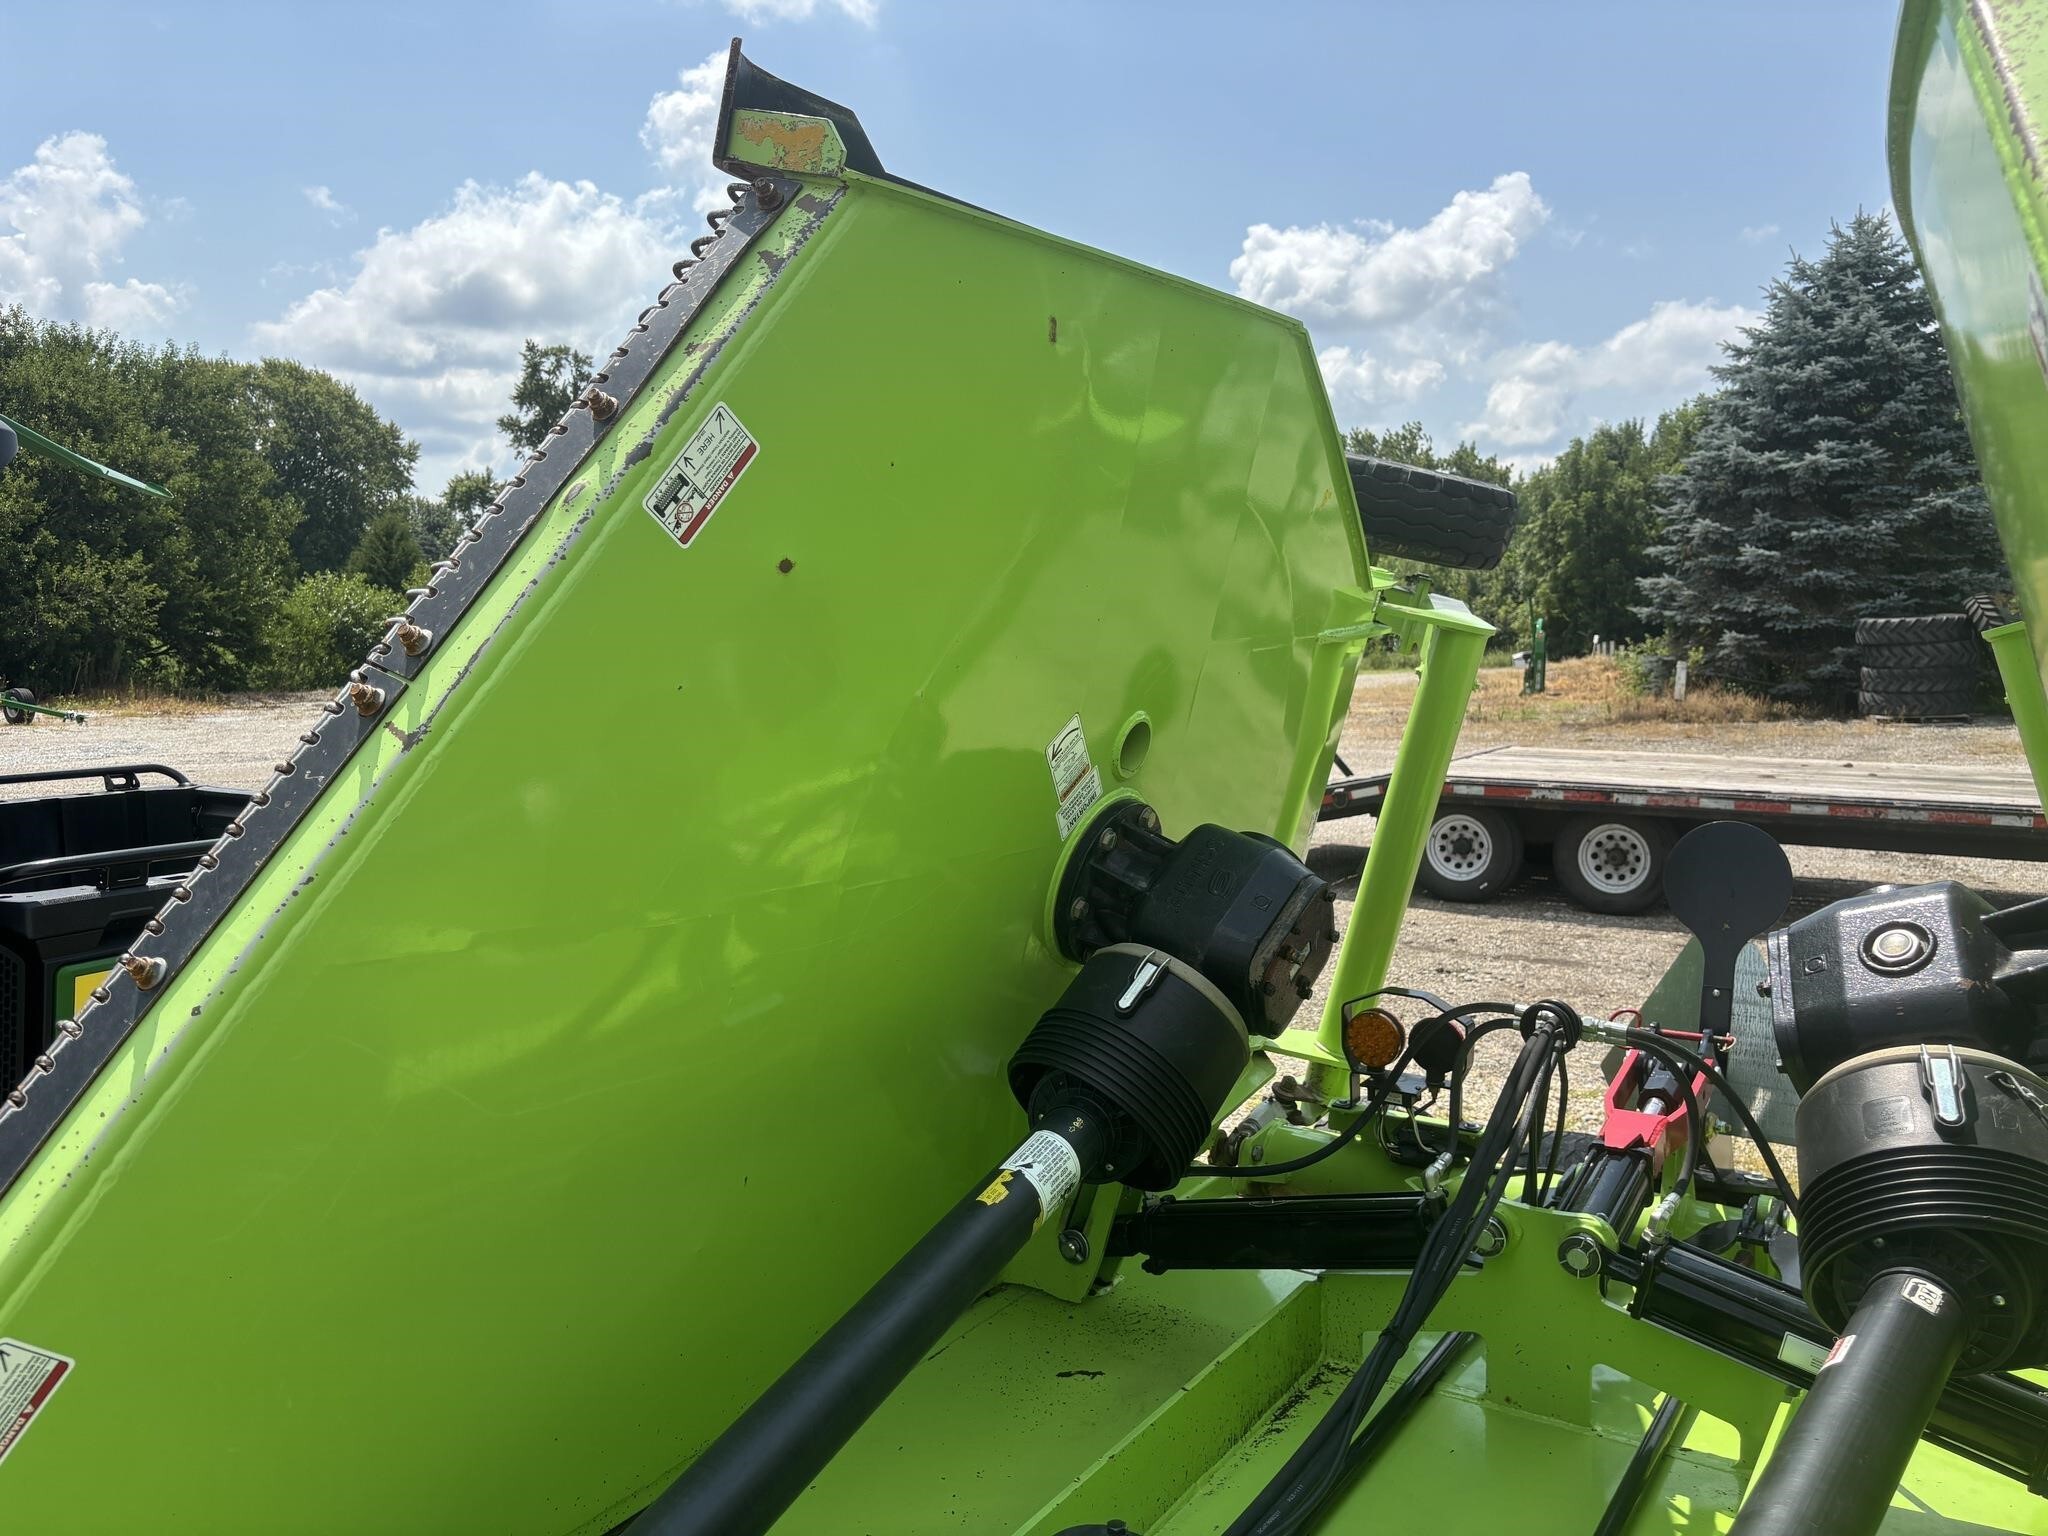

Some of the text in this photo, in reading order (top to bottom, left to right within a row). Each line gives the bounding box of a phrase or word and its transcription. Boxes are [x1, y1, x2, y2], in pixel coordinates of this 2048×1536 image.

[695, 431, 715, 456] HERE
[704, 478, 729, 511] DANGER
[1065, 790, 1097, 832] IMPORTANT
